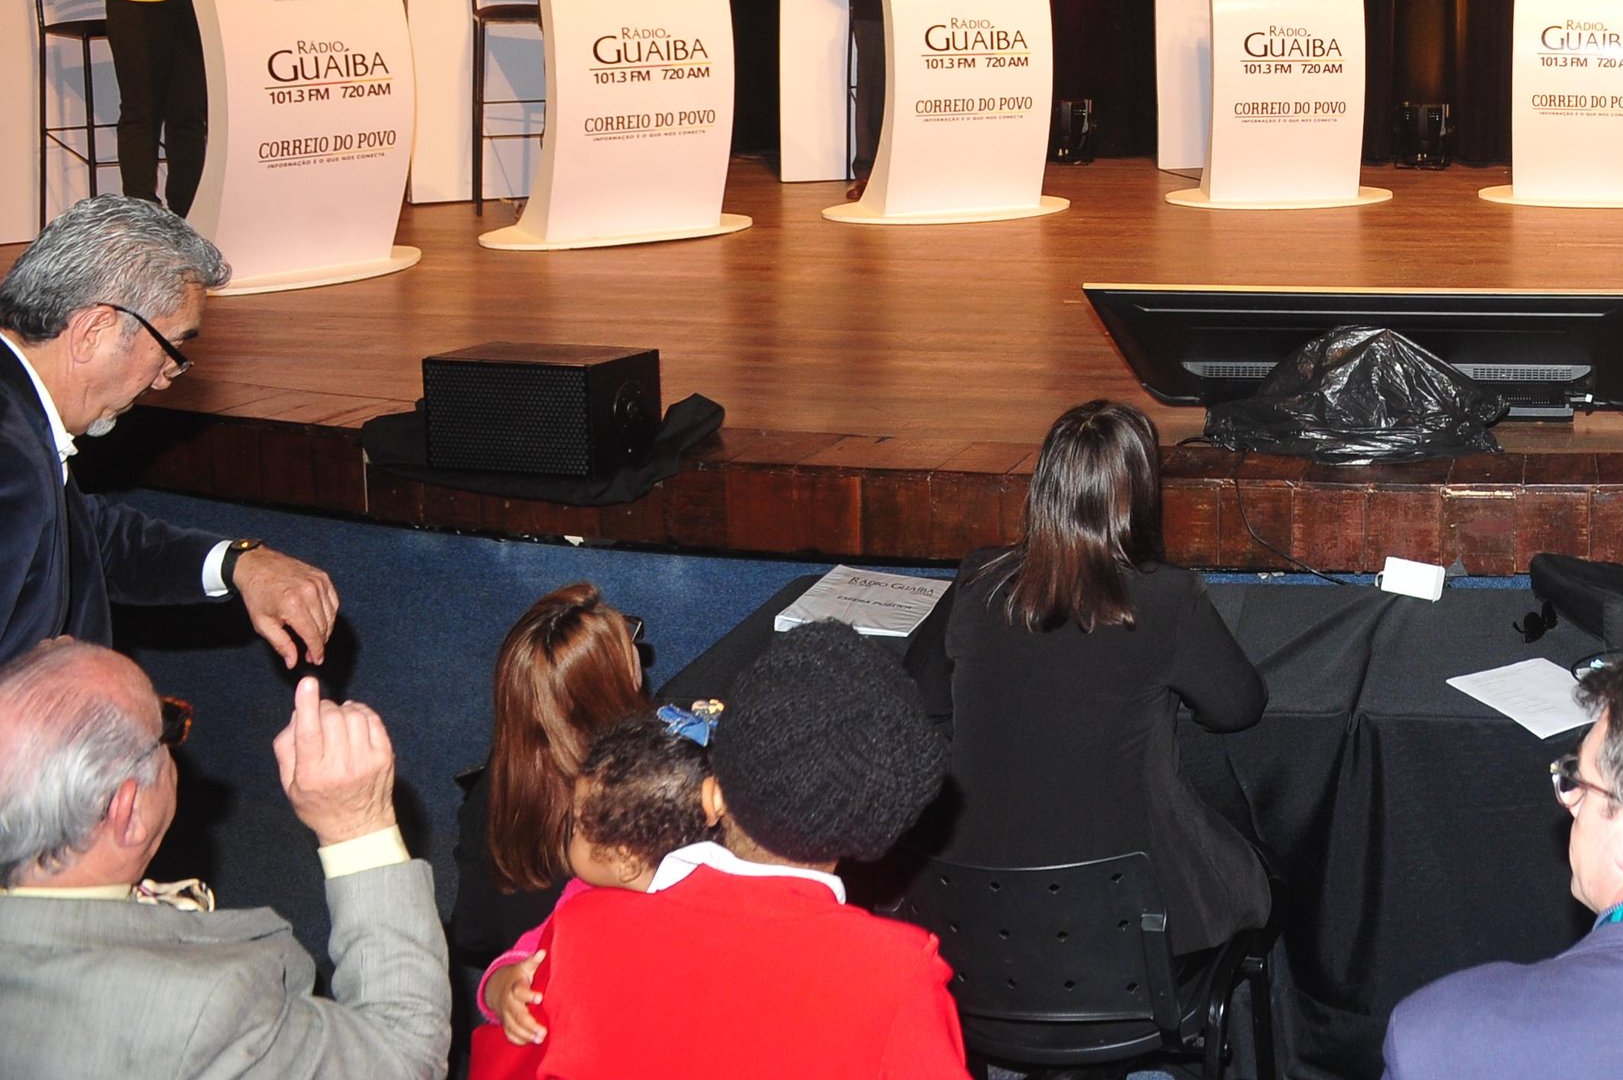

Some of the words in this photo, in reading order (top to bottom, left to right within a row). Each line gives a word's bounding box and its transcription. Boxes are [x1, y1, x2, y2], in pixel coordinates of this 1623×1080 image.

[622, 27, 666, 39] RÁDIO
[925, 25, 1027, 51] GUAÍBA
[297, 40, 344, 54] RÁDIO
[593, 35, 708, 64] GUAÍBA
[1244, 32, 1342, 57] GUAÍBA
[267, 48, 389, 82] GUAÍBA
[925, 58, 954, 69] 101.3
[958, 58, 975, 68] FM
[985, 57, 1005, 68] 720
[1008, 56, 1028, 67] AM
[1244, 64, 1272, 74] 101.3
[1274, 64, 1292, 74] FM
[1301, 64, 1320, 73] 720
[1323, 64, 1342, 73] AM
[1540, 57, 1567, 67] 101.3
[1571, 57, 1588, 67] FM
[1597, 58, 1616, 68] 720
[594, 72, 627, 84] 101.3
[630, 70, 650, 82] FM
[661, 68, 684, 80] 720
[687, 67, 709, 78] AM
[270, 90, 304, 105] 101.3
[309, 88, 329, 101] FM
[341, 85, 364, 98] 720
[367, 83, 391, 96] AM
[1532, 95, 1587, 107] CORREIO
[1591, 95, 1606, 108] DO
[916, 99, 974, 113] CORREIO
[978, 98, 995, 111] DO
[1000, 97, 1032, 110] POVO
[1235, 102, 1290, 115] CORREIO
[1294, 102, 1310, 114] DO
[1314, 101, 1346, 114] POVO
[585, 114, 650, 132] CORREIO
[655, 112, 674, 127] DO
[679, 110, 715, 125] POVO
[259, 137, 328, 159] CORREIO
[333, 134, 353, 151] DO
[358, 130, 396, 149] POVO
